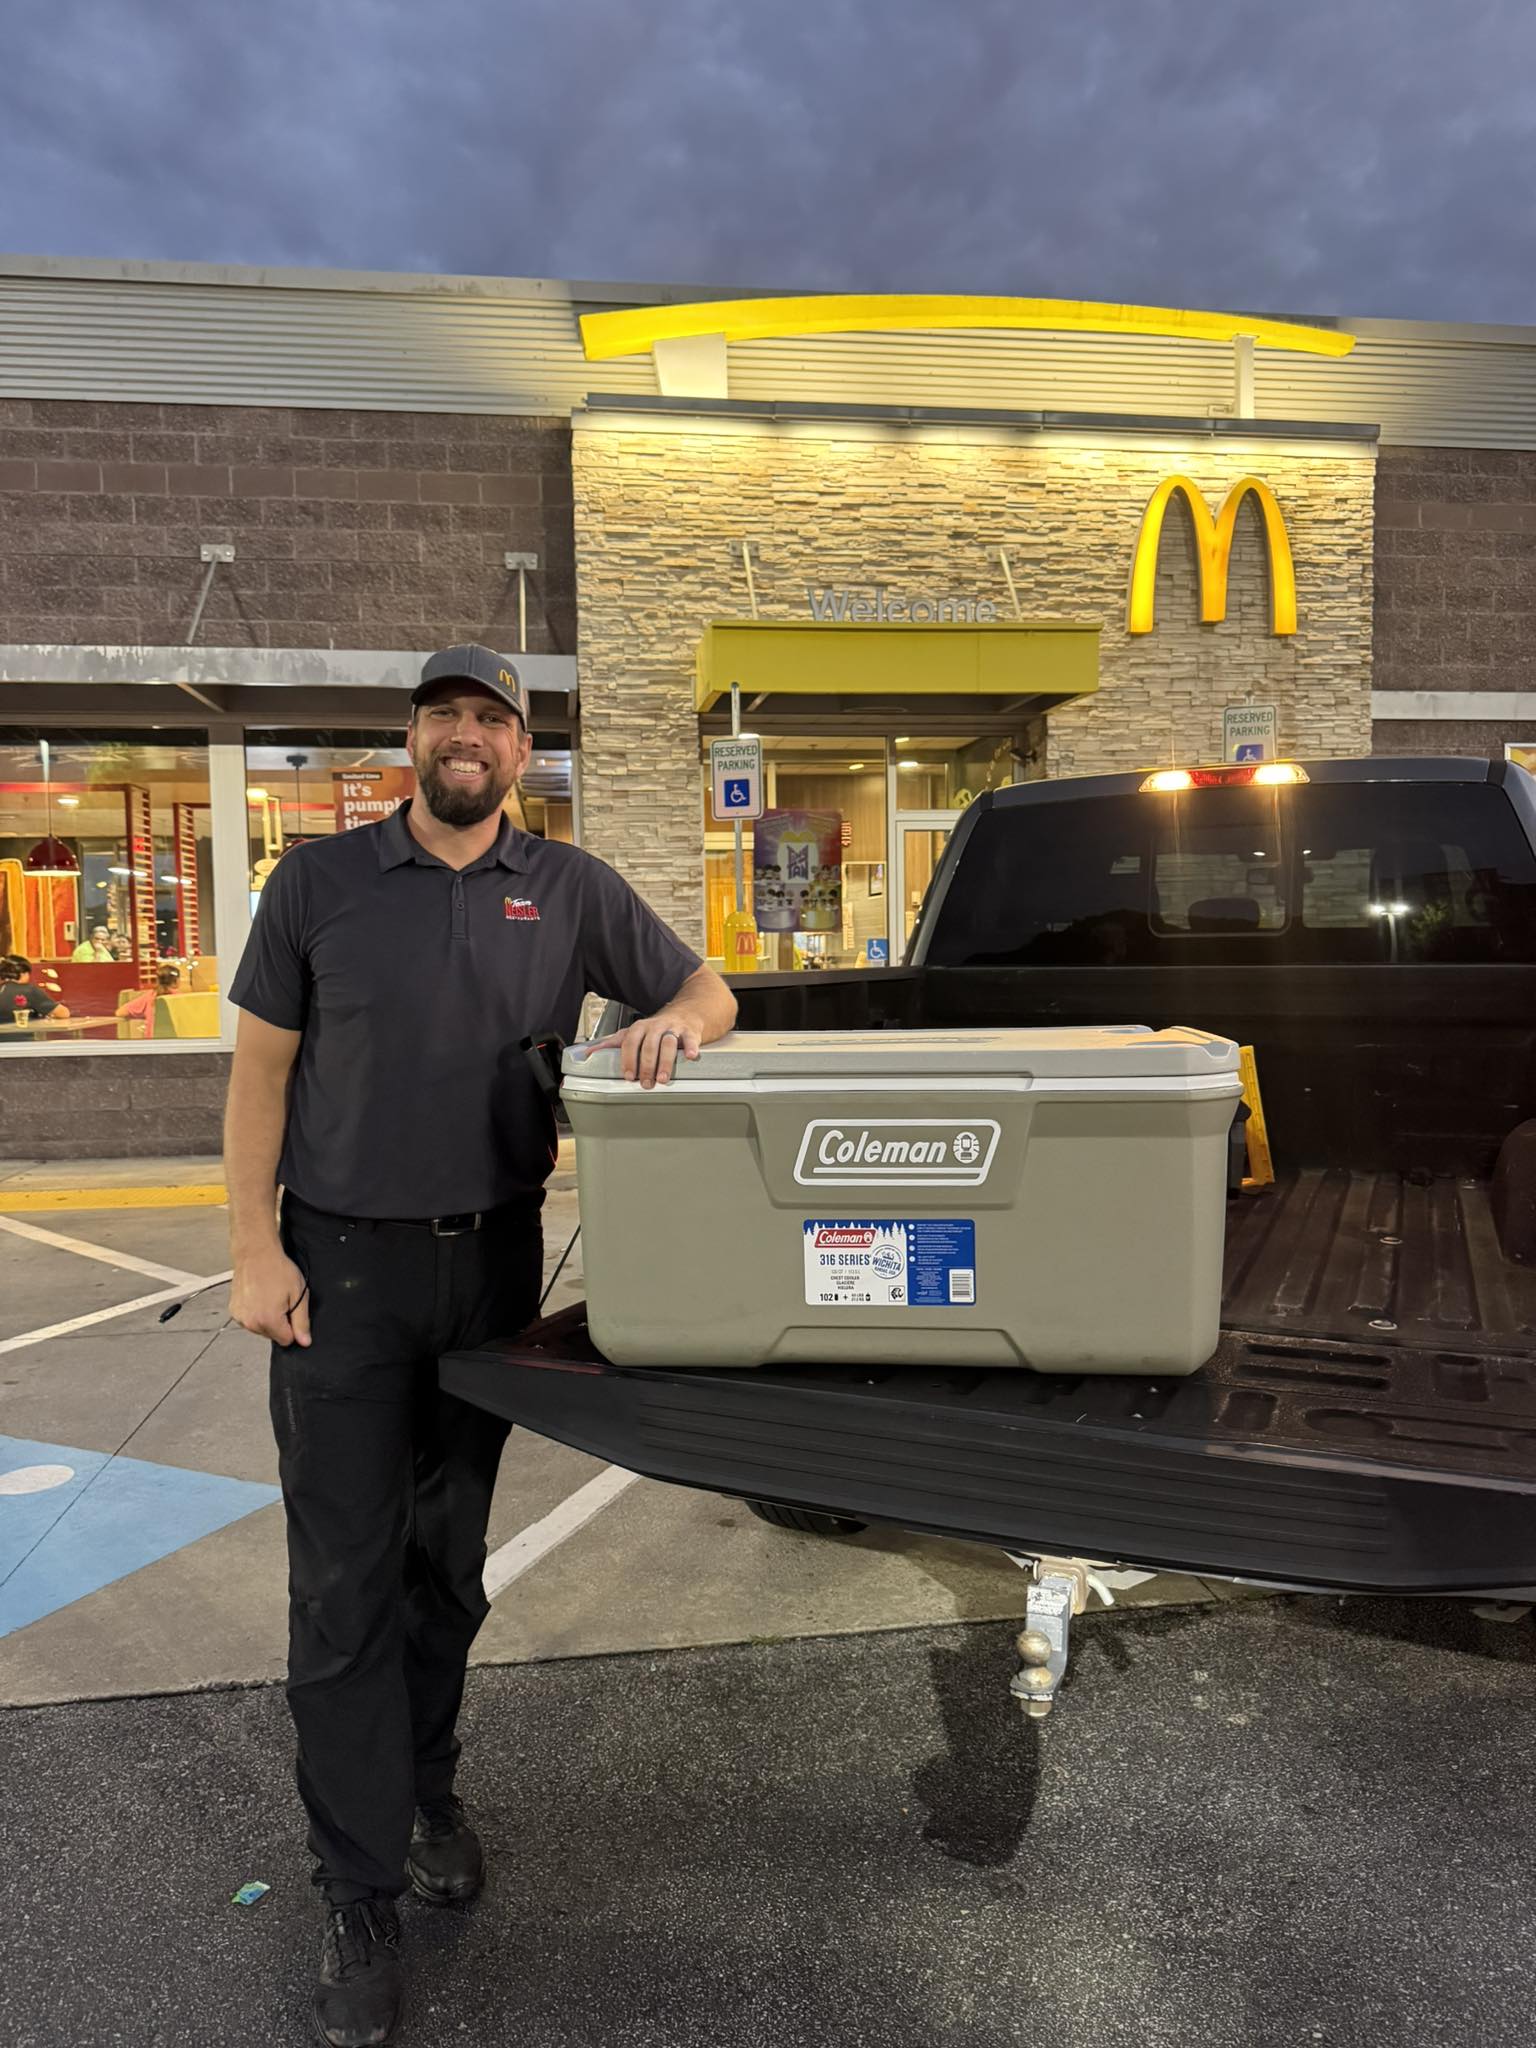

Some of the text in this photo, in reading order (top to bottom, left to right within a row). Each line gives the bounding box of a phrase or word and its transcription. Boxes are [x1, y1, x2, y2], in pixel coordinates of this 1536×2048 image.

[808, 585, 997, 623] Welcome
[1227, 711, 1273, 724] RESERVED
[1230, 725, 1271, 737] PARKING
[714, 744, 757, 758] RESERVED
[717, 758, 755, 771] PARKING
[343, 782, 372, 797] It's
[818, 1129, 947, 1165] Coleman
[819, 1230, 863, 1244] Coleman
[819, 1254, 836, 1266] 316
[838, 1254, 870, 1266] SERIES
[872, 1256, 902, 1272] WICHITA
[820, 1293, 834, 1302] 102
